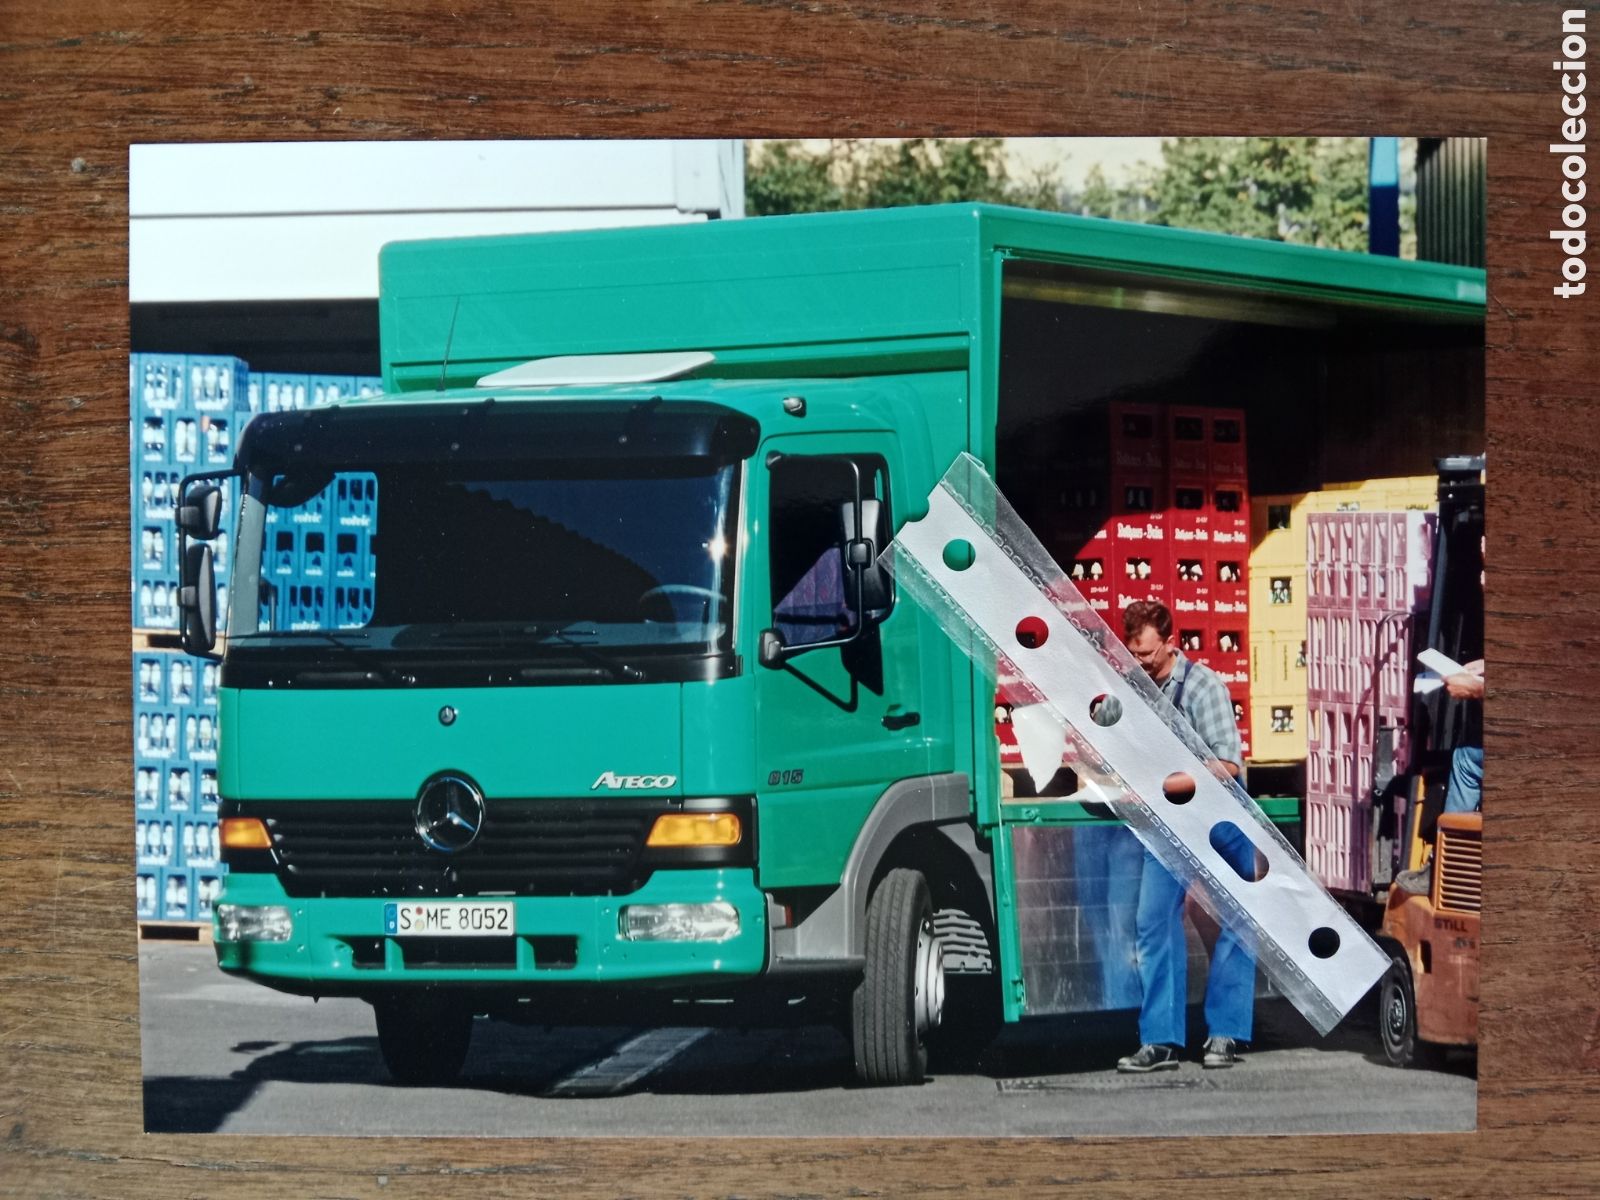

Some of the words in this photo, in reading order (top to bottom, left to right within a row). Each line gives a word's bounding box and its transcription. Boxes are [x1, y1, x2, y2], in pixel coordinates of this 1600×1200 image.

[400, 907, 412, 930] S
[427, 907, 452, 930] ME
[458, 907, 509, 930] 8052
